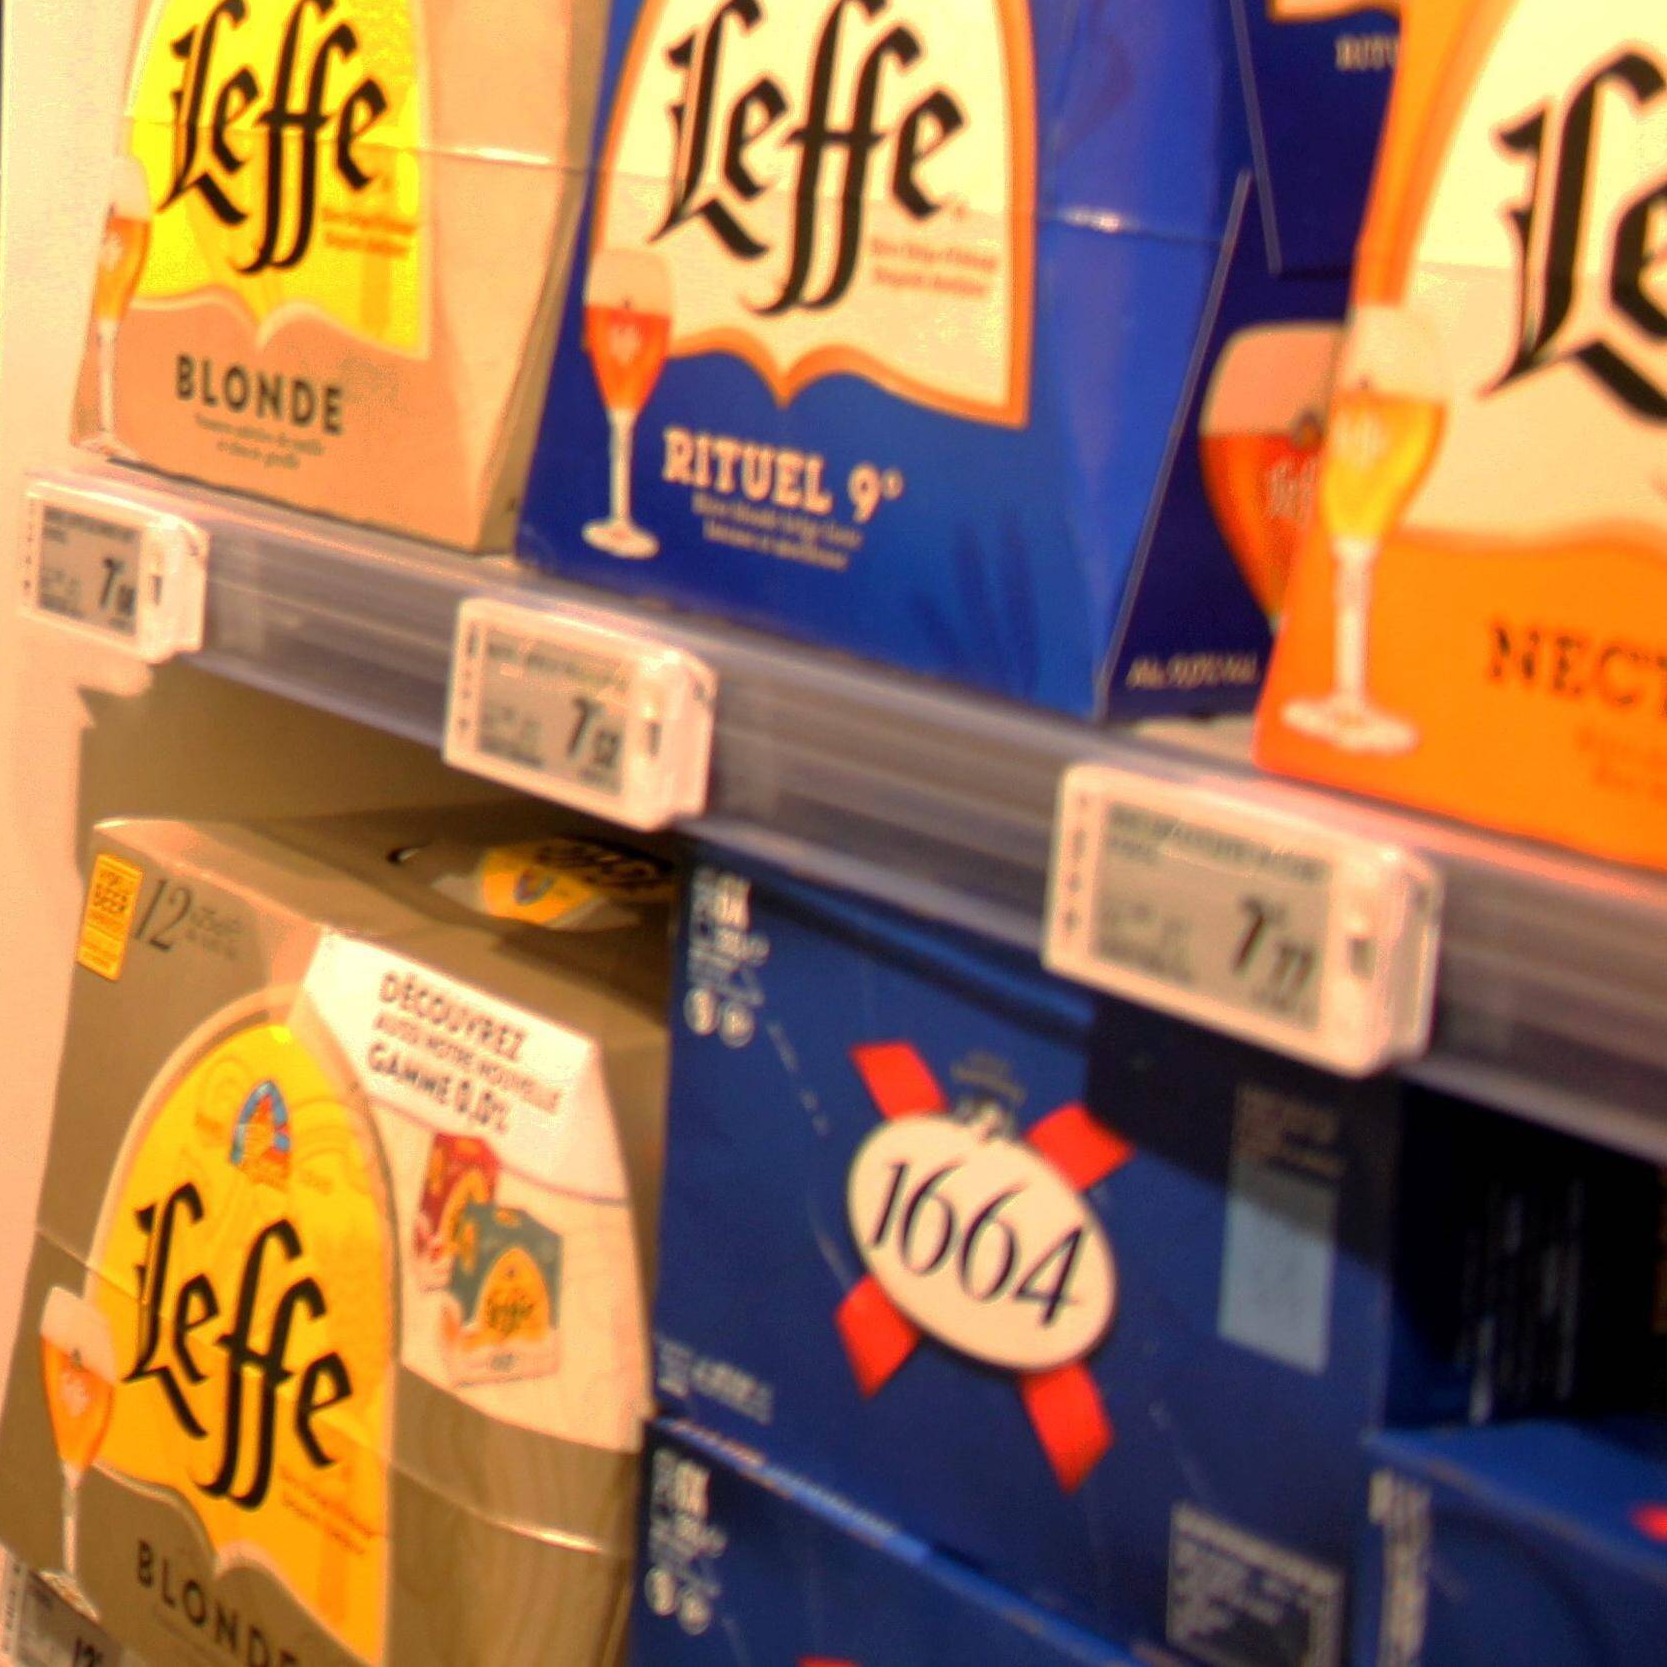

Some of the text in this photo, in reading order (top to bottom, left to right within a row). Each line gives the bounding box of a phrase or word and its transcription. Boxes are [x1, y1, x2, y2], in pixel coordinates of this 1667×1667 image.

[174, 353, 347, 436] BLONDE
[662, 425, 906, 525] RITUEL 9°
[134, 877, 193, 953] 12
[380, 971, 527, 1062] DÉCOUVREZ
[368, 1042, 451, 1107] GAMME
[869, 1154, 1092, 1331] 1664
[122, 1180, 353, 1513] Leffe
